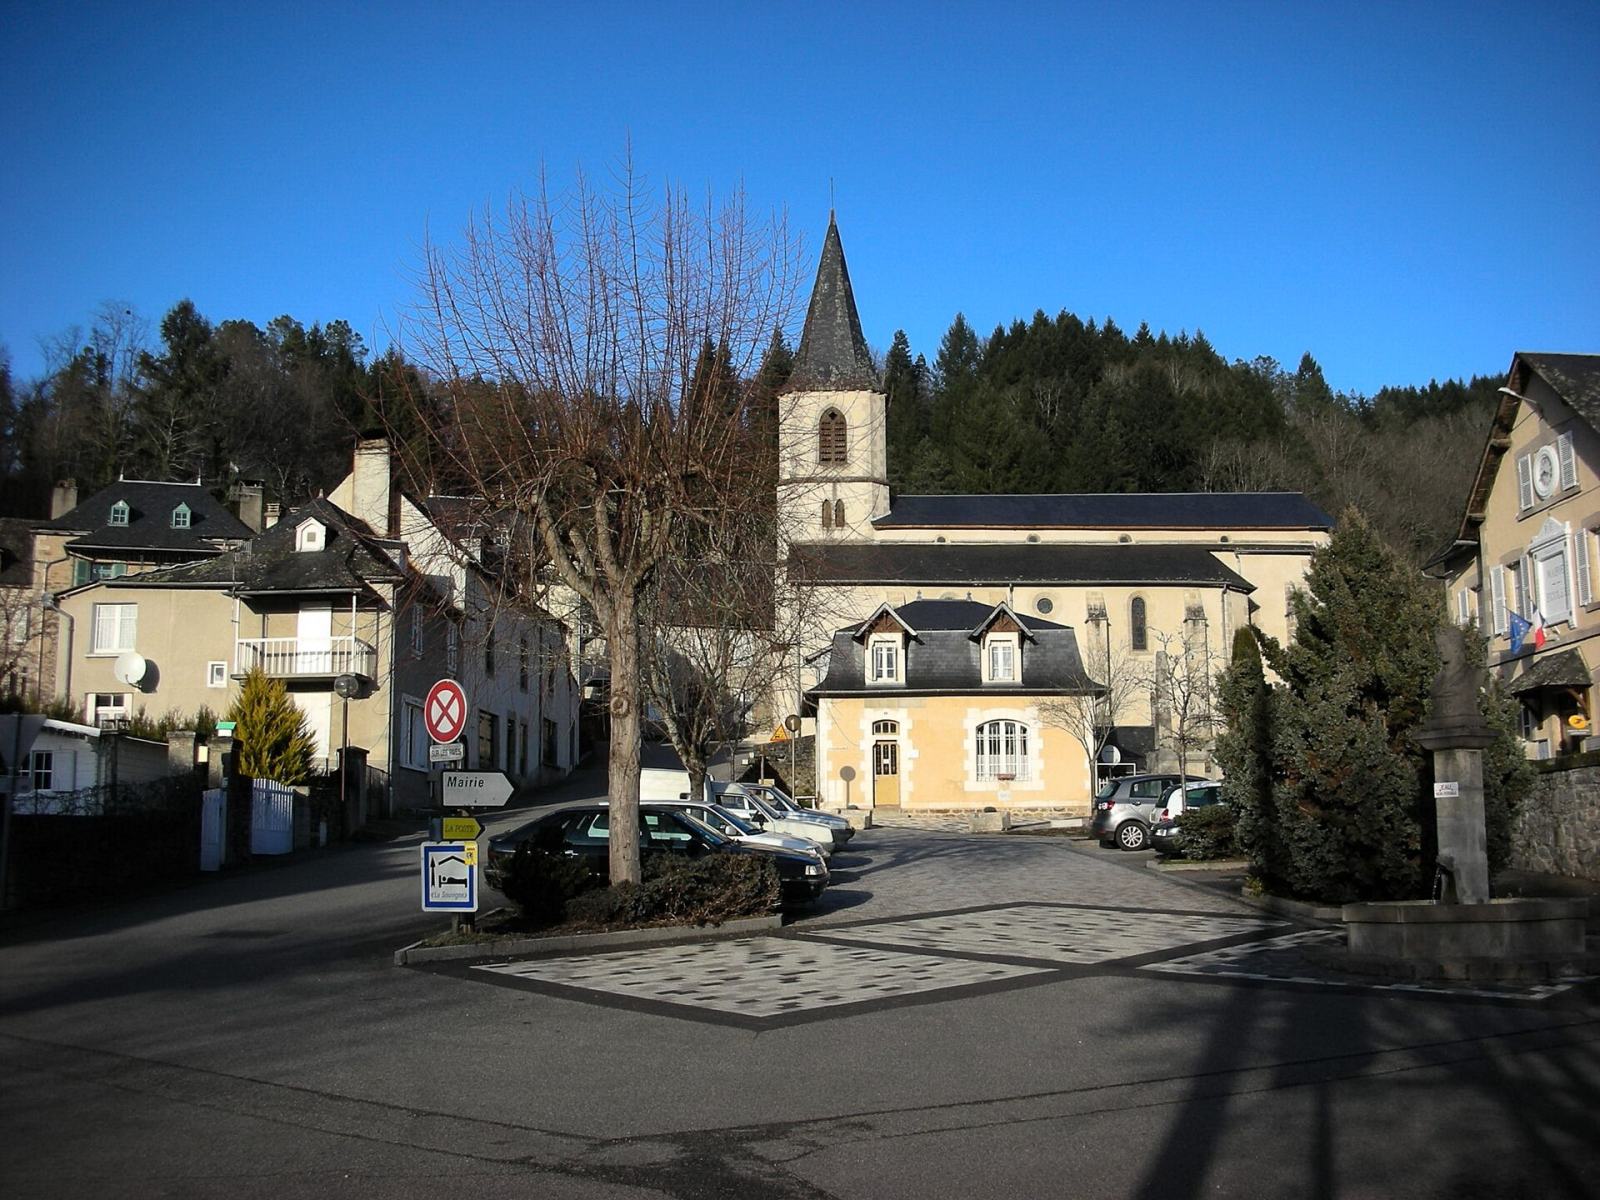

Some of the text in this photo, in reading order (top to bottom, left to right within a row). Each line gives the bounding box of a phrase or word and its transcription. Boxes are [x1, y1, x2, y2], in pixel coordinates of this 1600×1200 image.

[447, 775, 485, 788] Mairie
[445, 824, 475, 833] LA POSTE
